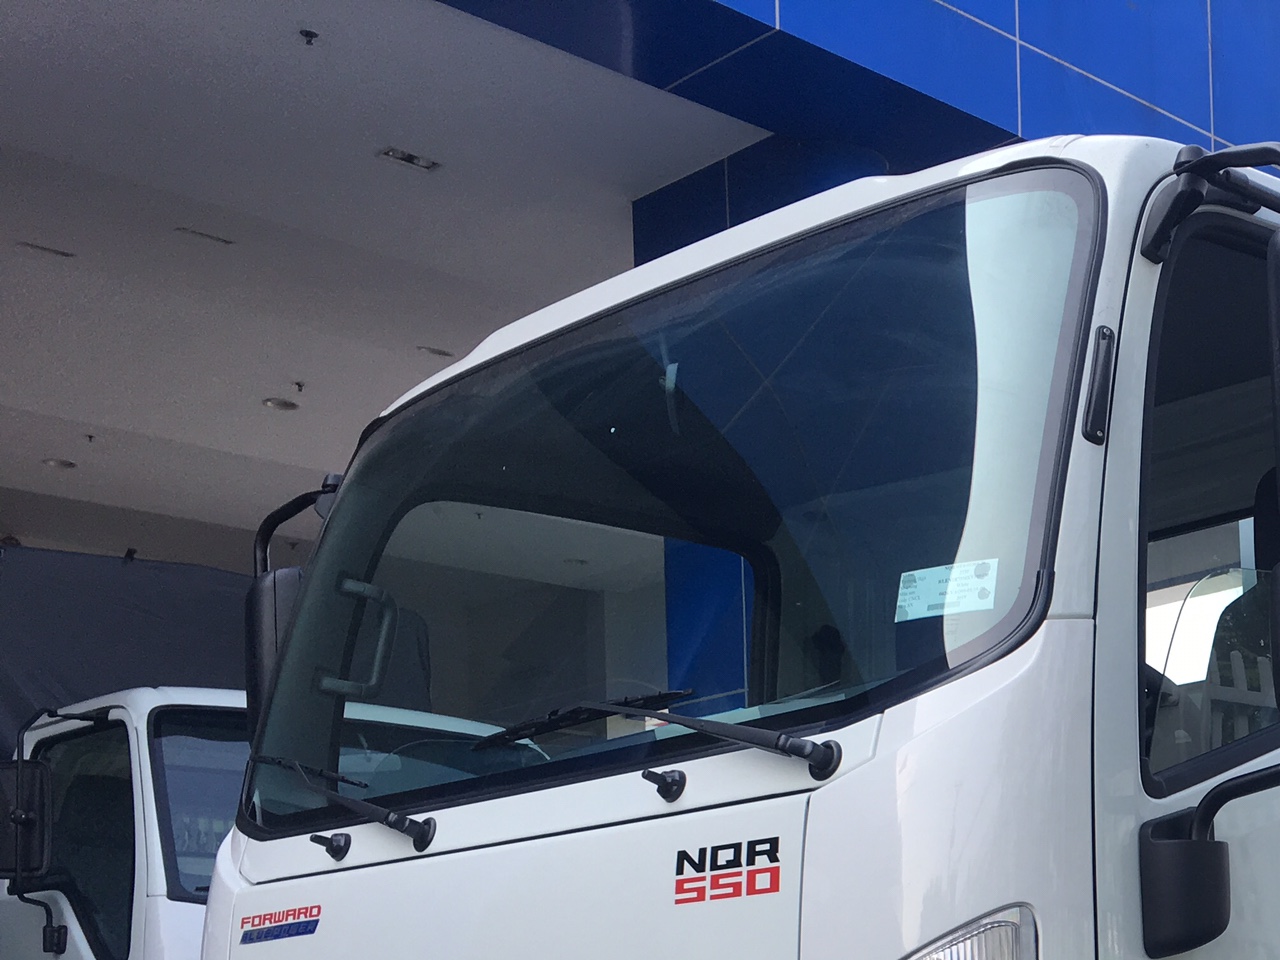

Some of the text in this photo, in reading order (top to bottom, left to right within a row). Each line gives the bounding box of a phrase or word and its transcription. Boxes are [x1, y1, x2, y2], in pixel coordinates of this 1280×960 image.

[675, 836, 780, 877] NQR
[674, 865, 781, 905] 550
[240, 904, 322, 930] FORWARD
